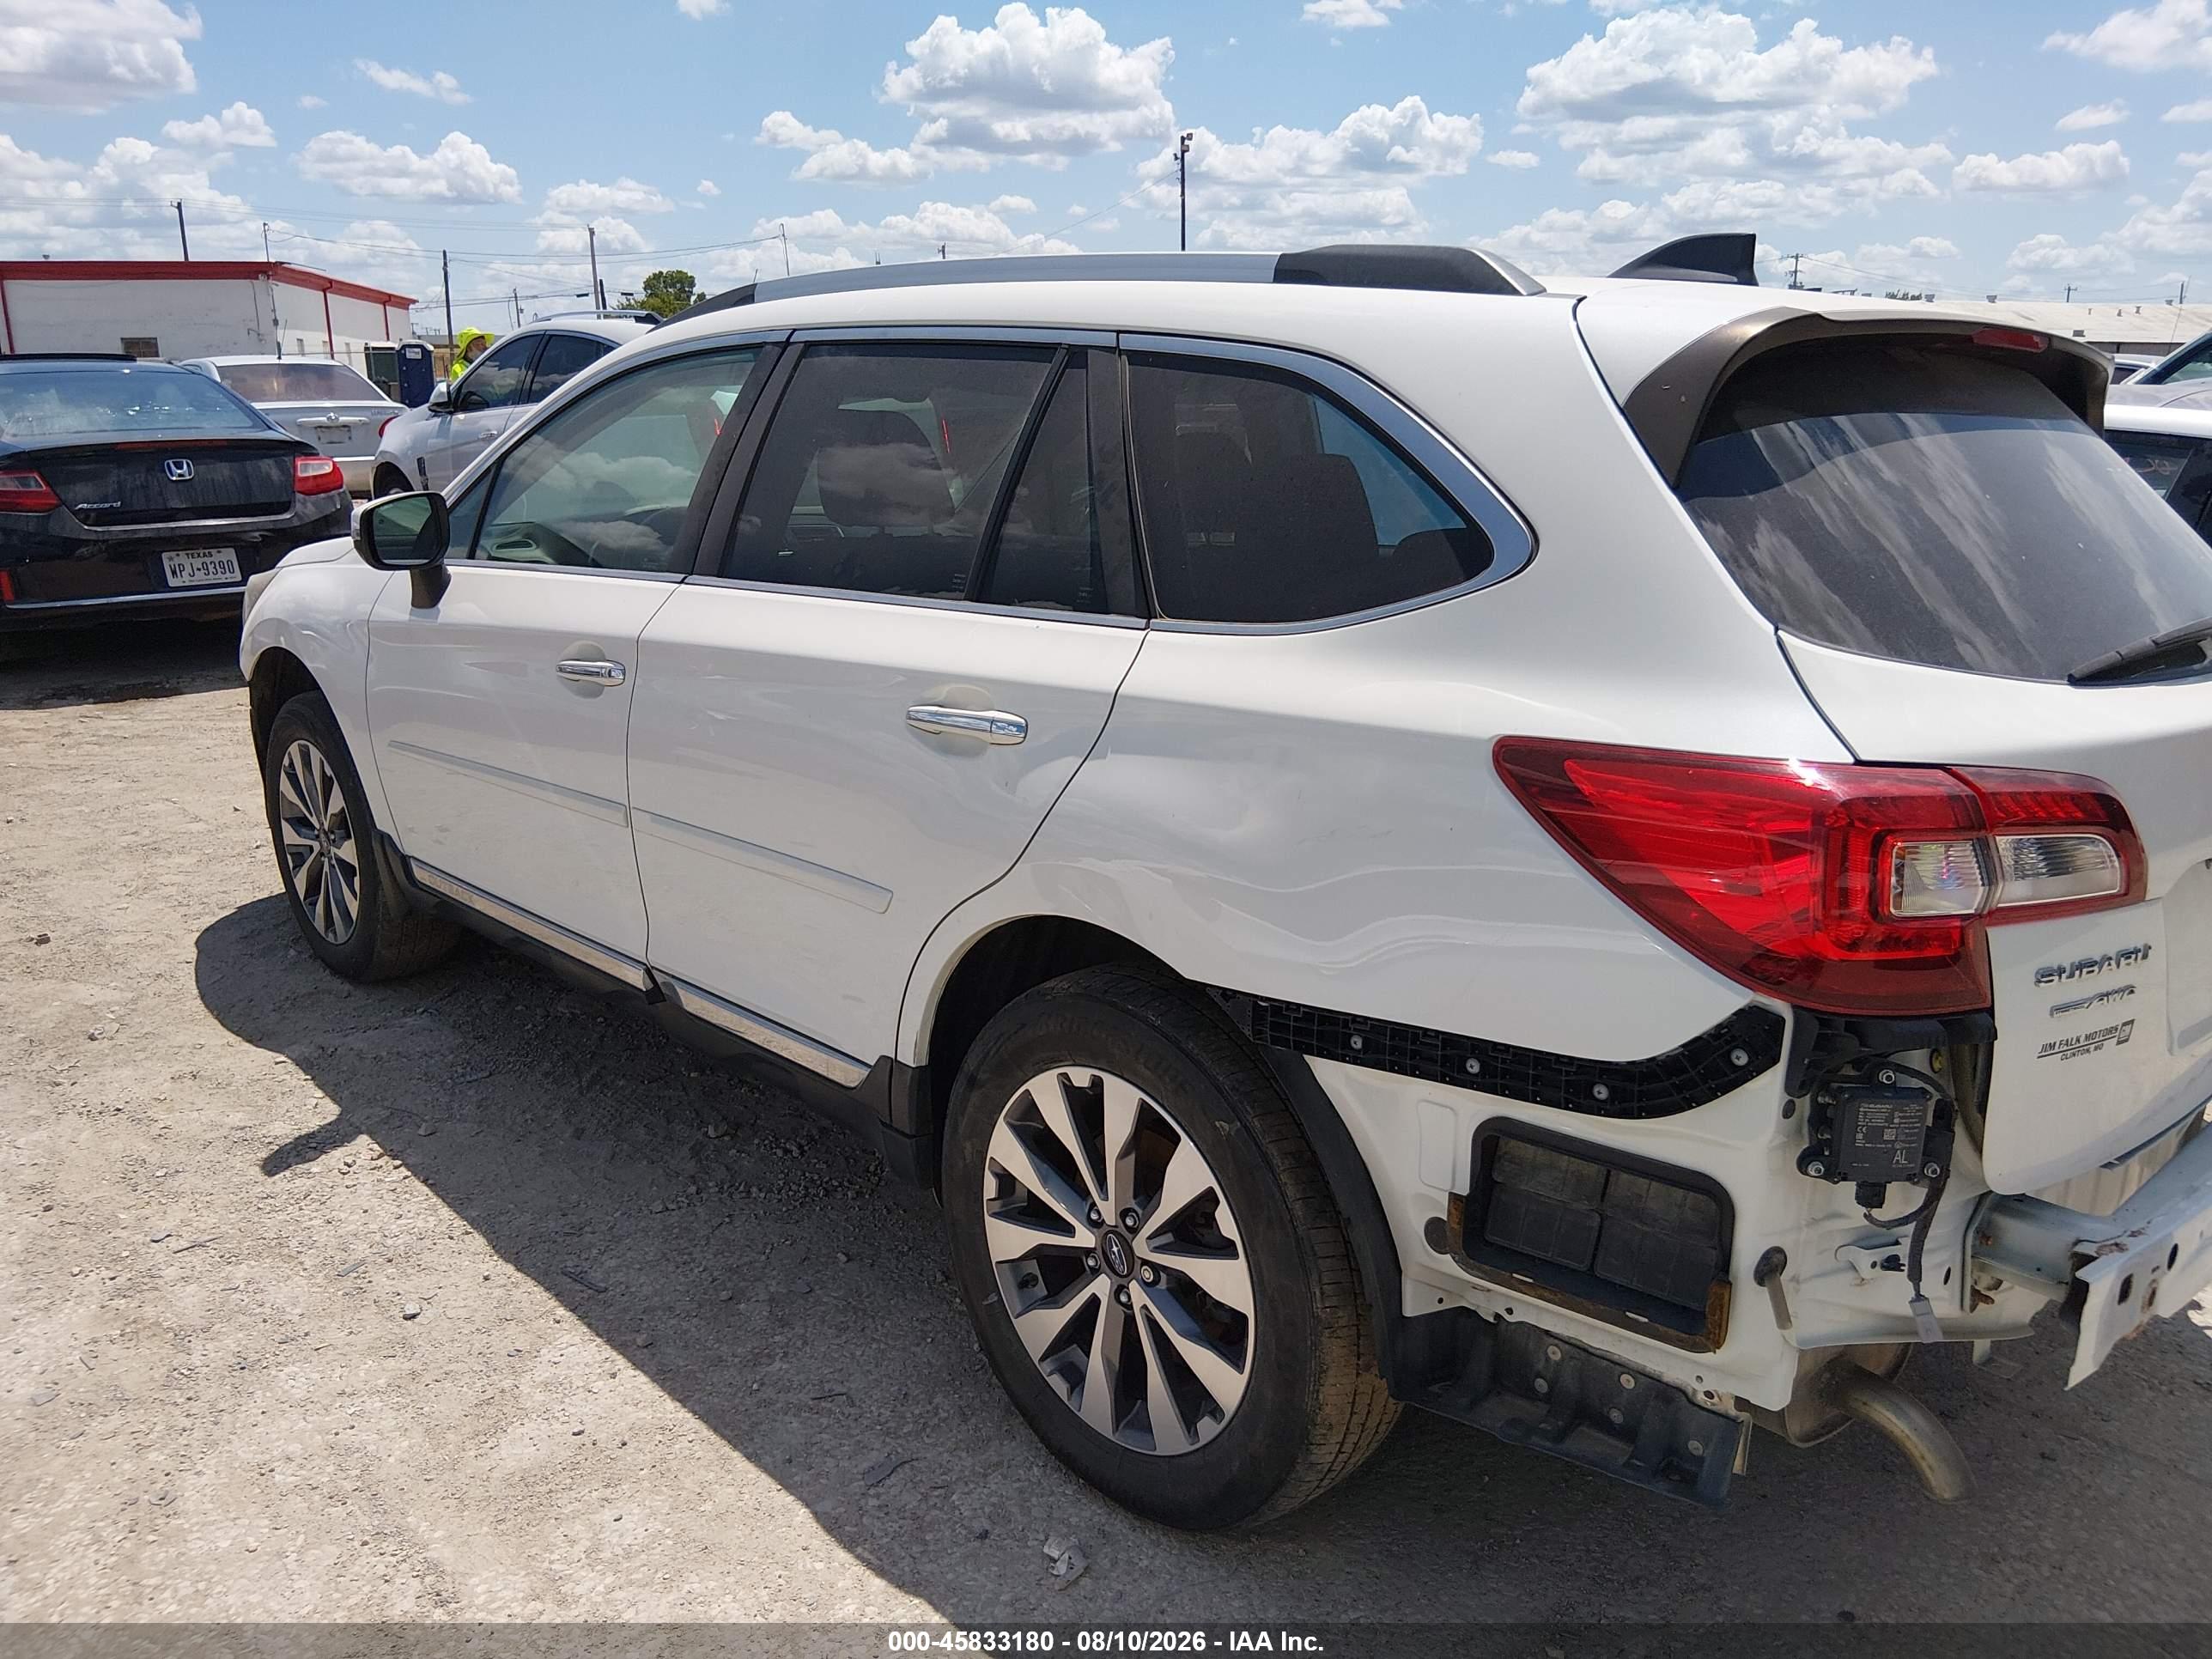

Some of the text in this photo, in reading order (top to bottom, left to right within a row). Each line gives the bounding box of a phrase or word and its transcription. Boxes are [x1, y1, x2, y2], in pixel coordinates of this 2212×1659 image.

[185, 550, 214, 560] TEXAS
[2038, 1040, 2057, 1054] JIM
[2057, 1034, 2082, 1049] FALK
[2082, 1024, 2120, 1042] MOTORS
[1892, 1149, 1909, 1164] AL
